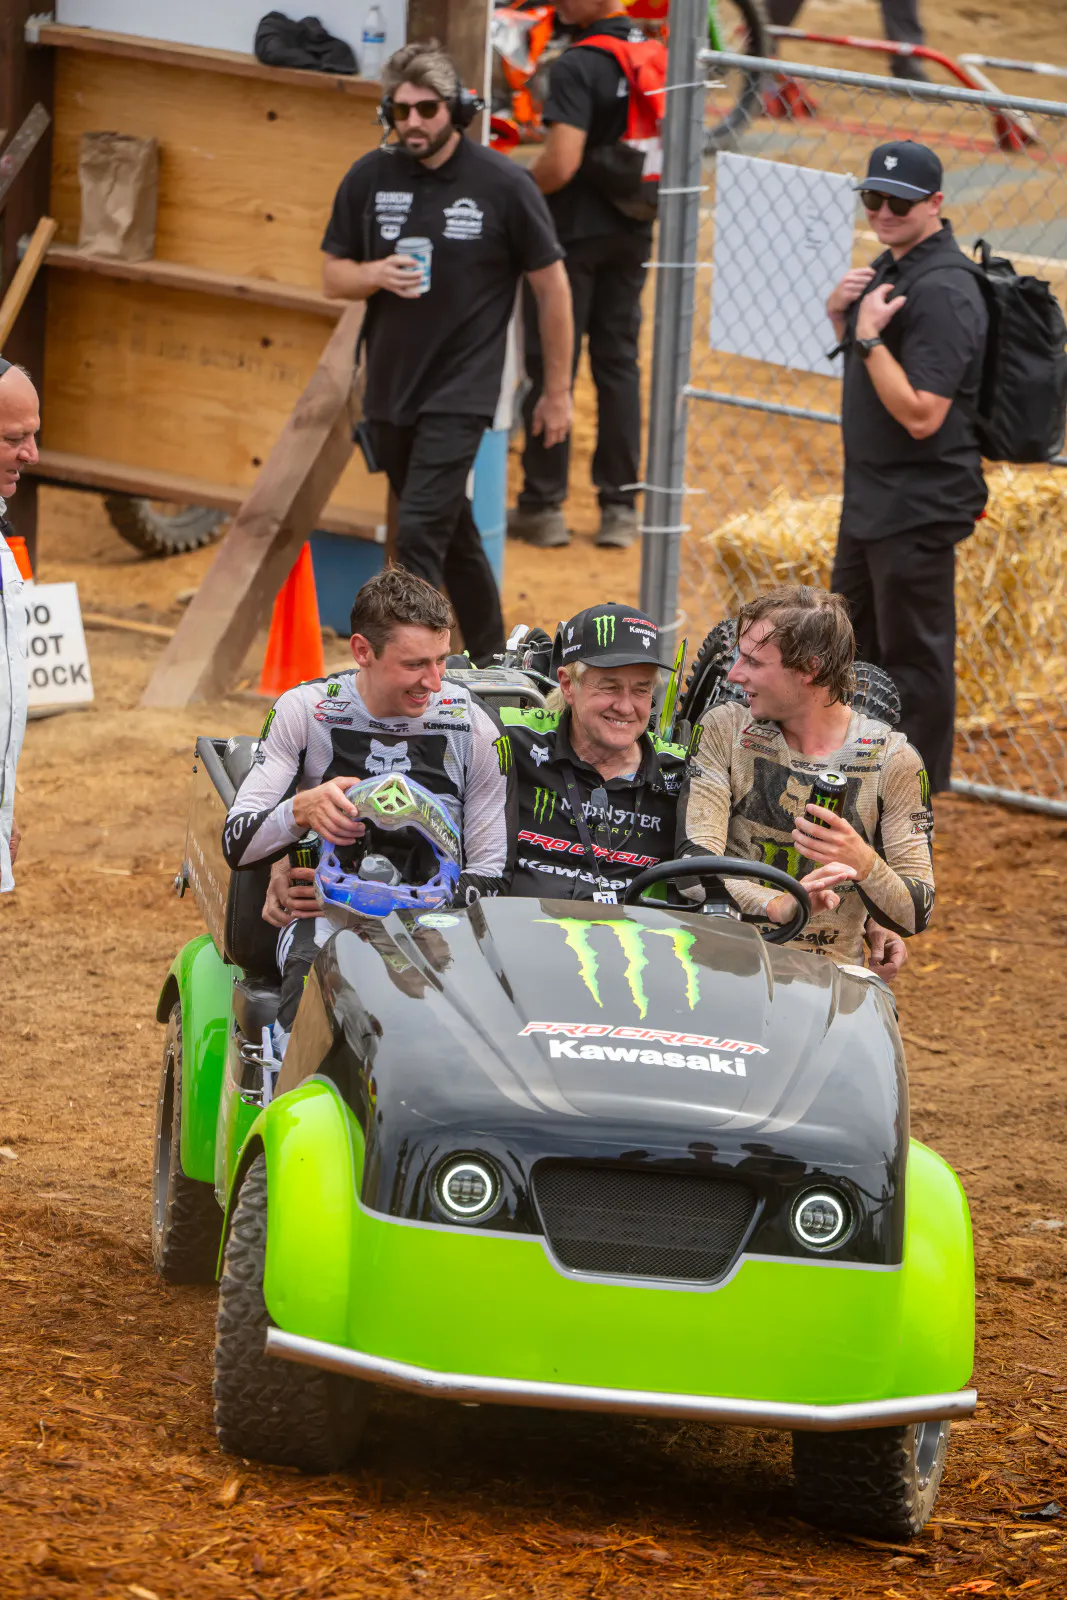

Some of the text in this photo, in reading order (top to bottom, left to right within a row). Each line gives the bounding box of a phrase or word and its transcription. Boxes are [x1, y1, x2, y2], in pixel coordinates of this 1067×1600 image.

[26, 634, 64, 658] OT
[629, 625, 657, 640] Kawasaki
[28, 663, 89, 688] OCK
[422, 721, 471, 733] Kawasaki
[840, 763, 884, 773] Kawasak
[561, 797, 661, 832] MONSTER
[517, 829, 661, 870] PRO CIRCUIT
[518, 857, 634, 891] Kawasa
[517, 1021, 770, 1055] PRO CIRCUIT
[549, 1039, 747, 1077] Kawasaki
